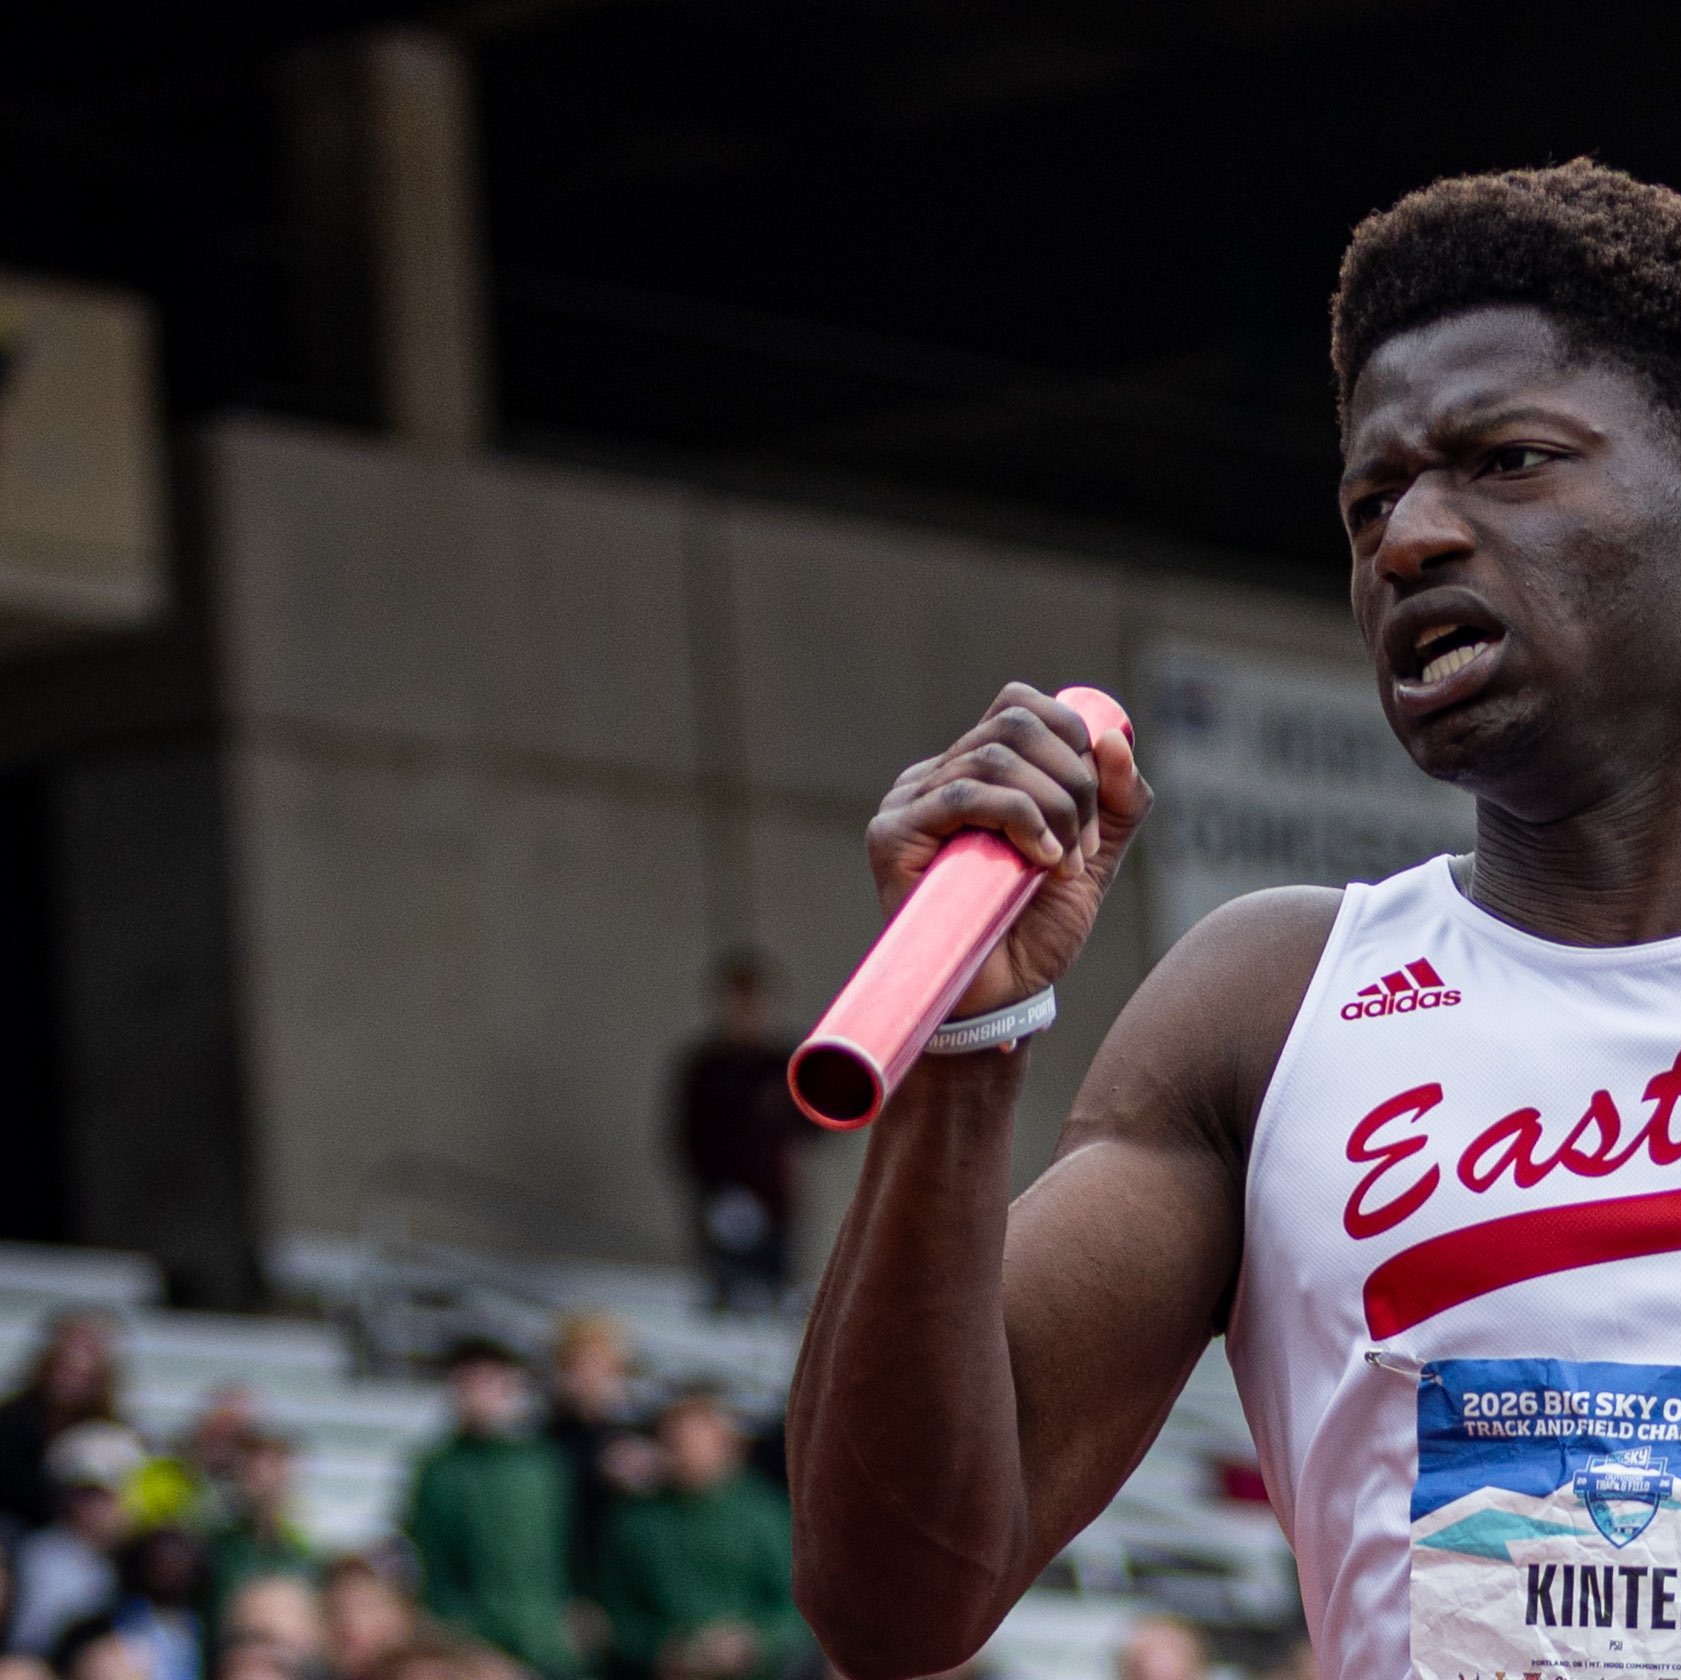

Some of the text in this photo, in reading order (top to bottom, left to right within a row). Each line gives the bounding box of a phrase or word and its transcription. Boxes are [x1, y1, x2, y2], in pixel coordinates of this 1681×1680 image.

[1341, 989, 1462, 1021] adidas
[1463, 1391, 1538, 1418] 2026
[1544, 1390, 1590, 1416] BIG
[1595, 1392, 1657, 1419] SKY
[1463, 1419, 1531, 1437] TRACK
[1534, 1419, 1575, 1437] AND
[1576, 1420, 1634, 1440] FIELD
[1609, 1640, 1623, 1650] PSU
[1626, 1663, 1670, 1671] COMMUNITY
